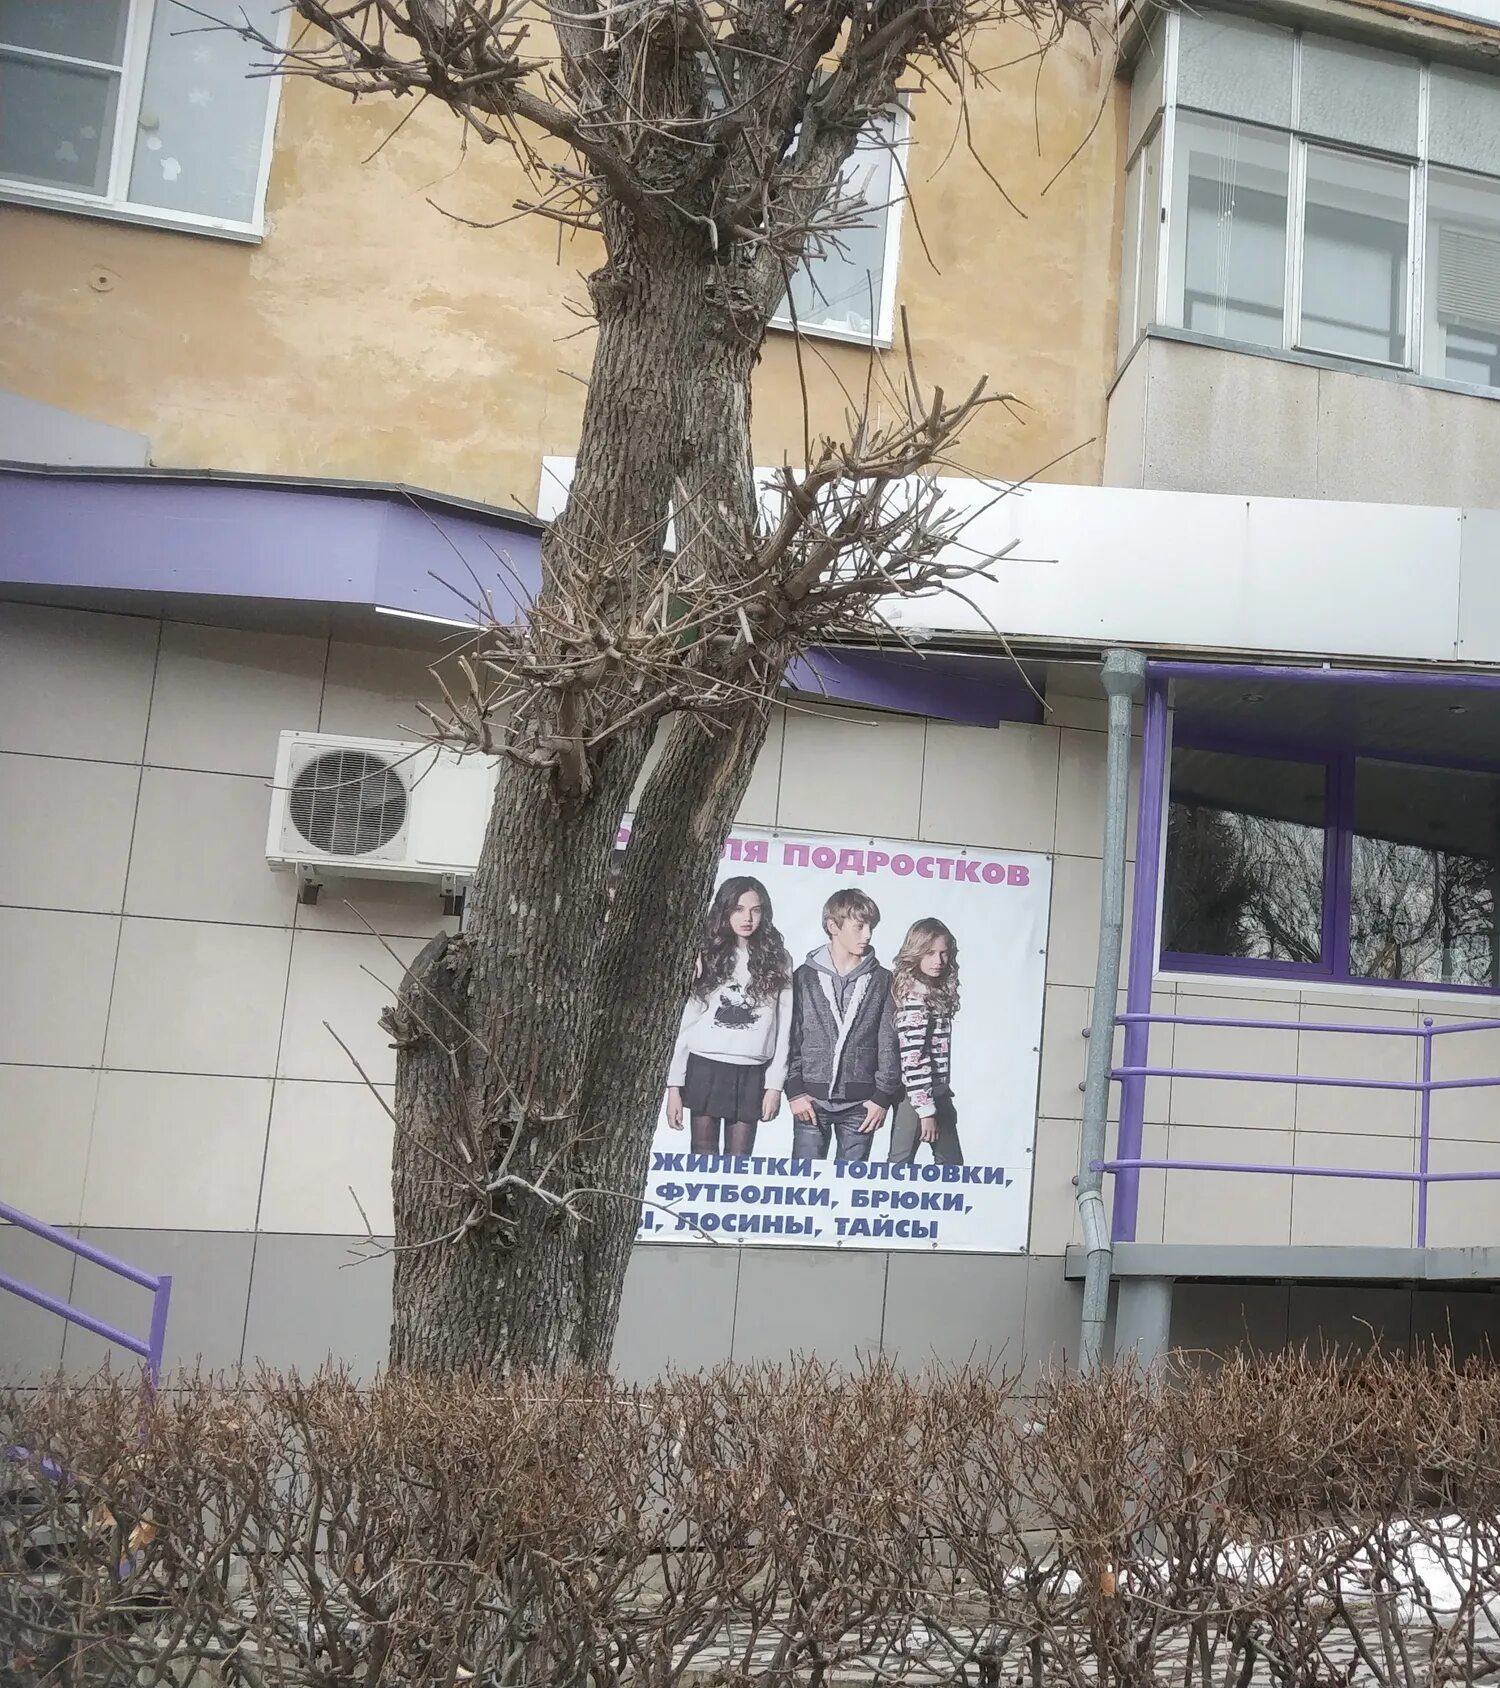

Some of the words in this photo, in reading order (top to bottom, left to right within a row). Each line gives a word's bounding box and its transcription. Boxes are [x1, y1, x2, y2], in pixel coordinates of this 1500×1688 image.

[720, 837, 769, 864] ЛЯ
[782, 843, 1031, 888] ПОДРОСТКОВ
[651, 1152, 822, 1180] ЖИЛЕТКИ,
[833, 1160, 1014, 1188] ТОЛСТОВКИ,
[655, 1182, 839, 1210] ФУТБОЛКИ,
[851, 1189, 973, 1215] БРЮКИ,
[674, 1211, 823, 1238] ЛОСИНЫ,
[834, 1213, 939, 1239] ТАЙСЫ
